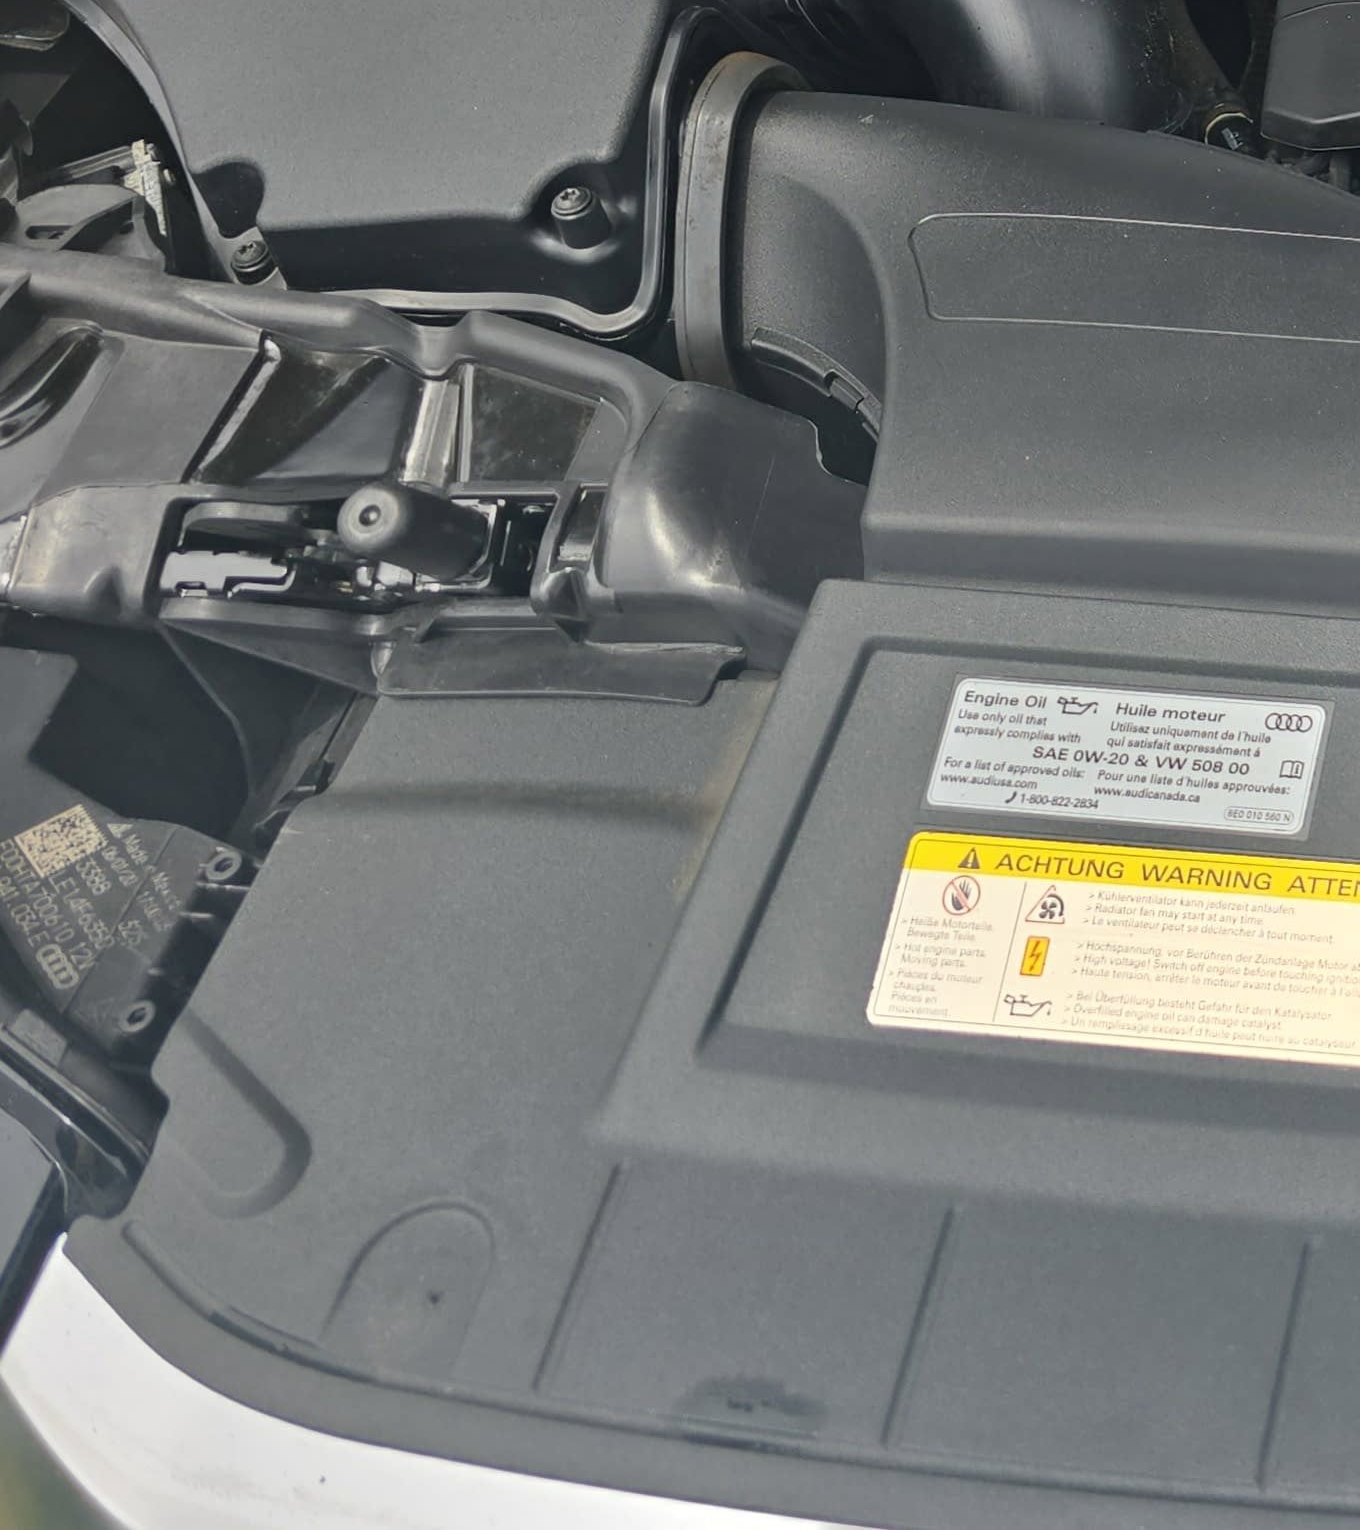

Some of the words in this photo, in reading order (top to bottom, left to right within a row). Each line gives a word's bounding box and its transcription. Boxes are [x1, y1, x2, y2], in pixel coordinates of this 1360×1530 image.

[964, 690, 1019, 707] Engine
[1025, 695, 1047, 708] Oil
[958, 708, 979, 720] Use
[981, 712, 1006, 724] only
[1008, 714, 1023, 724] oil
[1025, 715, 1047, 726] that
[1115, 702, 1157, 717] Huile
[1162, 709, 1226, 722] moteur
[954, 725, 1003, 739] expressly
[1006, 730, 1054, 741] complies
[1058, 733, 1081, 743] with
[1110, 720, 1150, 734] Utilisez
[1152, 725, 1219, 739] uniquement
[1220, 730, 1235, 740] de
[1106, 736, 1125, 748] qui
[1127, 739, 1171, 751] satisfait
[943, 756, 963, 767] For
[964, 761, 971, 769] a
[974, 759, 991, 771] list
[993, 761, 1006, 771] of
[1007, 764, 1060, 776] approved
[1061, 767, 1085, 778] oils:
[1032, 746, 1069, 761] SAE
[1073, 749, 1129, 765] 0W-20
[1134, 754, 1148, 767] &
[1155, 756, 1187, 770] VW
[1191, 759, 1223, 773] 508
[1228, 762, 1250, 775] 00
[940, 774, 1038, 789] www.audiusa.com
[1097, 769, 1124, 781] Pour
[1126, 774, 1147, 783] une
[1150, 774, 1173, 785] liste
[1222, 782, 1290, 795] approuvées:
[1021, 793, 1099, 809] 1-800-822-2834
[1094, 787, 1200, 803] www.audicanada.ca
[994, 853, 1124, 879] ACHTUNG
[1142, 863, 1272, 890] WARNING
